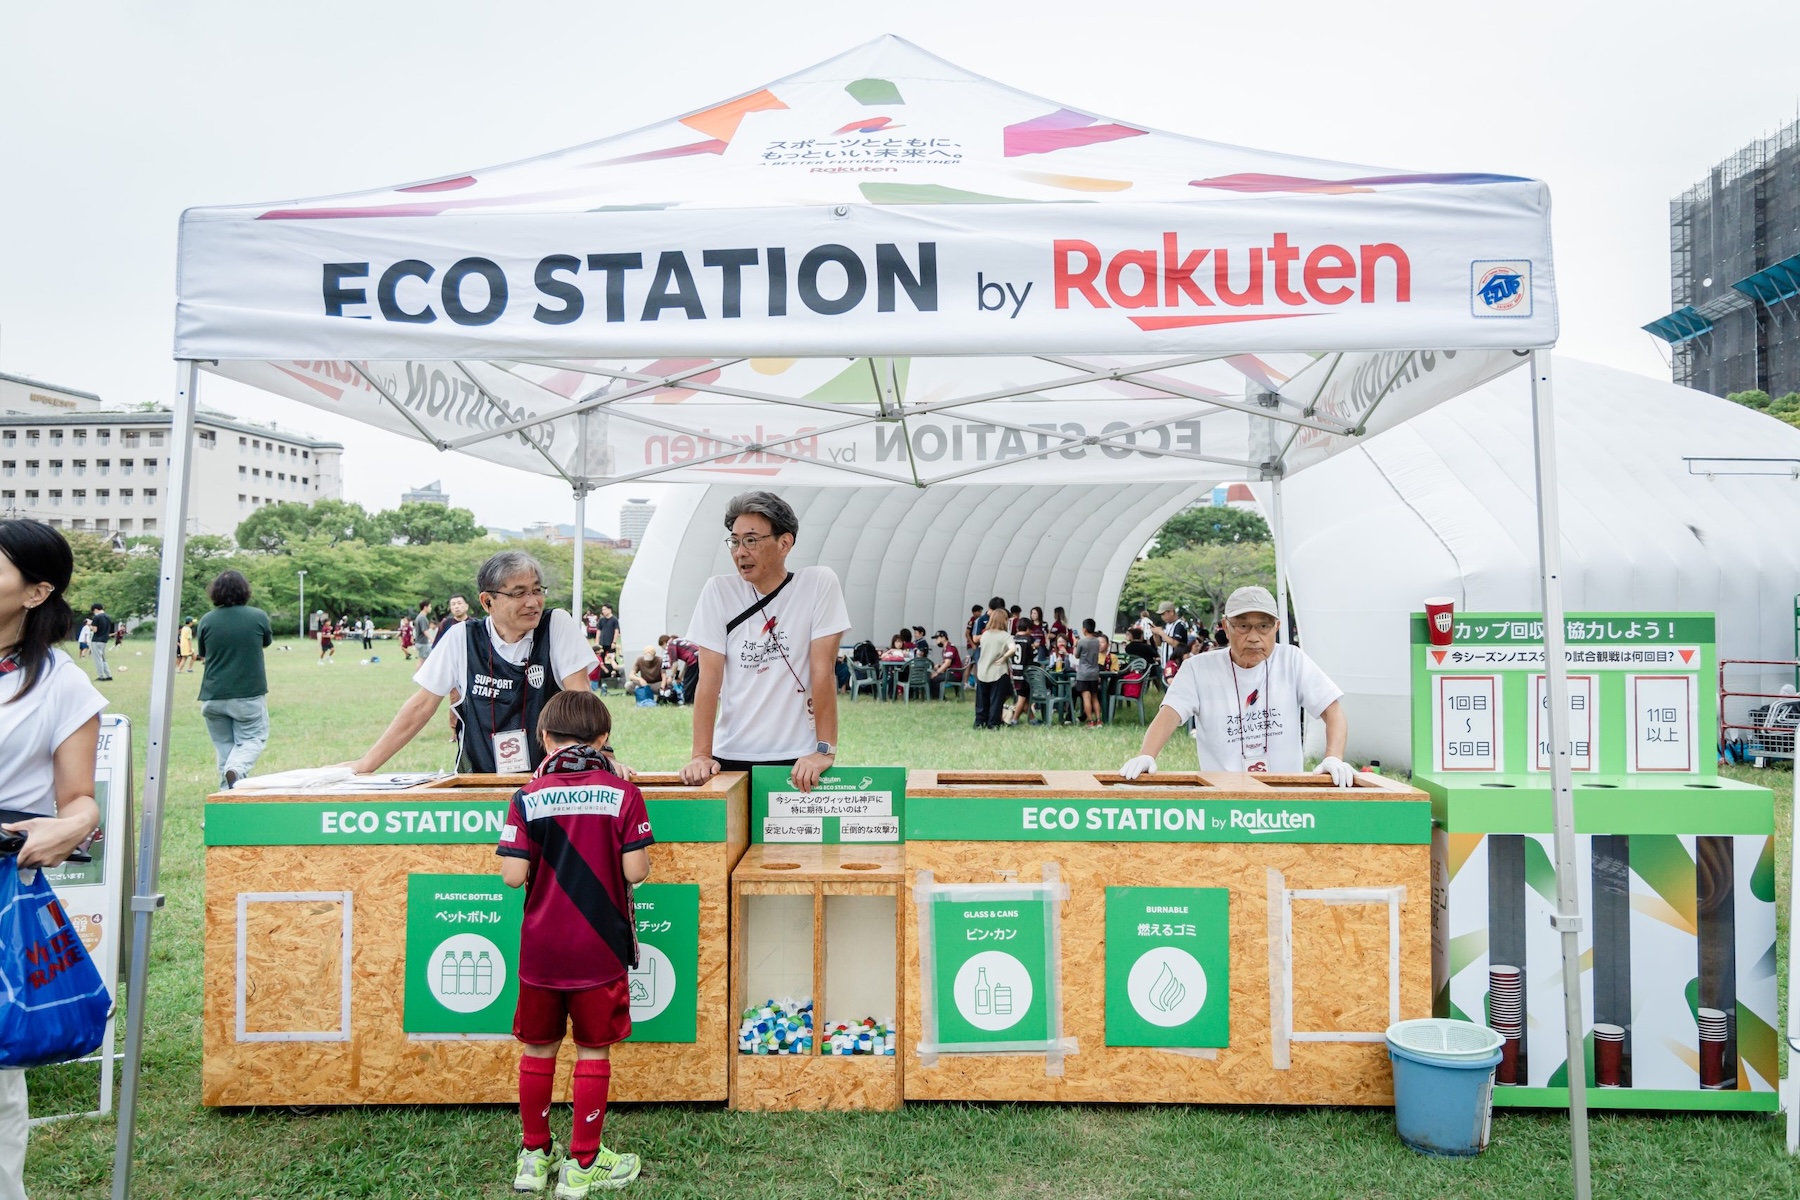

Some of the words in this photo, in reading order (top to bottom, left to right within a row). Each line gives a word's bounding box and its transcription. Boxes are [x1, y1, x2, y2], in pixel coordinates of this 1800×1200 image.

[765, 138, 961, 149] スポーツとともに、
[761, 148, 963, 160] もっといい未来へ。
[322, 257, 509, 326] ECO
[532, 242, 939, 326] STATION
[977, 272, 1033, 319] by
[1052, 231, 1412, 312] Rakuten
[1454, 621, 1676, 641] カップ回収協力しよう！
[1451, 650, 1674, 663] 今シーズンノエスの試合観戦は何回目?
[474, 673, 514, 690] SUPPORT
[471, 685, 500, 699] STAFF
[1448, 696, 1487, 710] 1回目
[1646, 708, 1677, 723] 11回
[1646, 728, 1679, 743] 以上
[1448, 741, 1491, 756] 5回目
[541, 789, 620, 806] WAKOHRE
[776, 795, 884, 805] 今シーズンのヴィッセル神戸に
[791, 806, 868, 814] 特に期待したいのは？
[321, 811, 380, 834] ECO
[385, 810, 505, 833] STATION
[1022, 807, 1080, 830] ECO
[1085, 807, 1205, 831] STATION
[1211, 816, 1227, 831] by
[1230, 808, 1315, 829] Rakuten
[765, 826, 821, 835] 安定した守備力
[841, 825, 898, 835] 圧倒的な攻撃力
[434, 893, 468, 901] PLASTIC
[468, 893, 503, 901] BOTTLES
[435, 910, 502, 924] ペットボトル
[963, 910, 988, 918] GLASS
[990, 910, 996, 918] &
[996, 910, 1019, 918] CANS
[1145, 906, 1189, 914] BURNABLE
[966, 927, 1018, 941] ビン・カン
[1137, 922, 1197, 937] 燃えるゴミ
